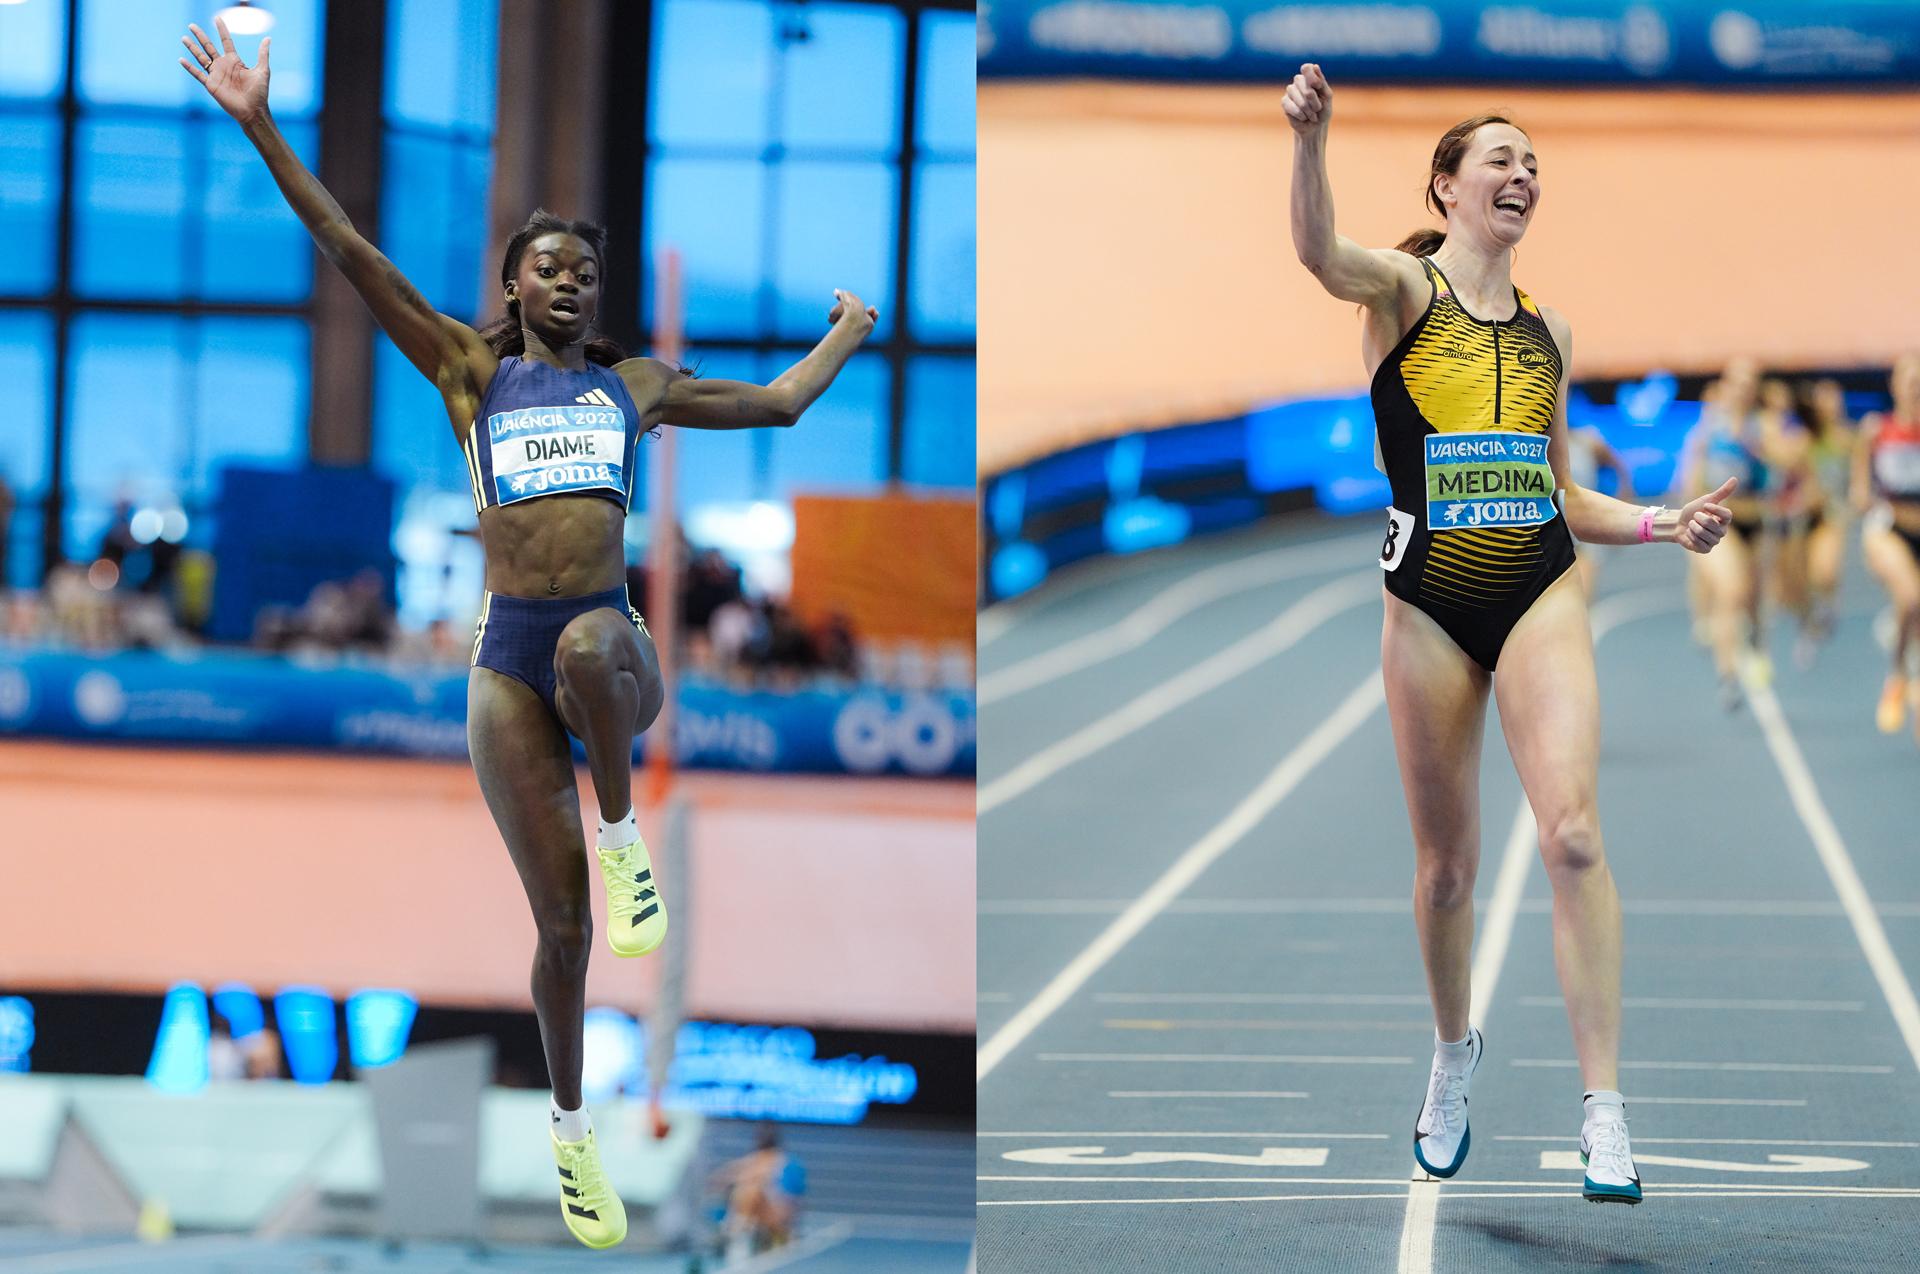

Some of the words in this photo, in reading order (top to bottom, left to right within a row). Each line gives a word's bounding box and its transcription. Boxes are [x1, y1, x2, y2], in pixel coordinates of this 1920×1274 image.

[1442, 350, 1474, 361] amura
[575, 412, 617, 425] 2027
[524, 434, 596, 462] DIAME
[1512, 441, 1543, 458] 2027
[1438, 469, 1546, 496] MEDINA
[1381, 518, 1400, 562] 8
